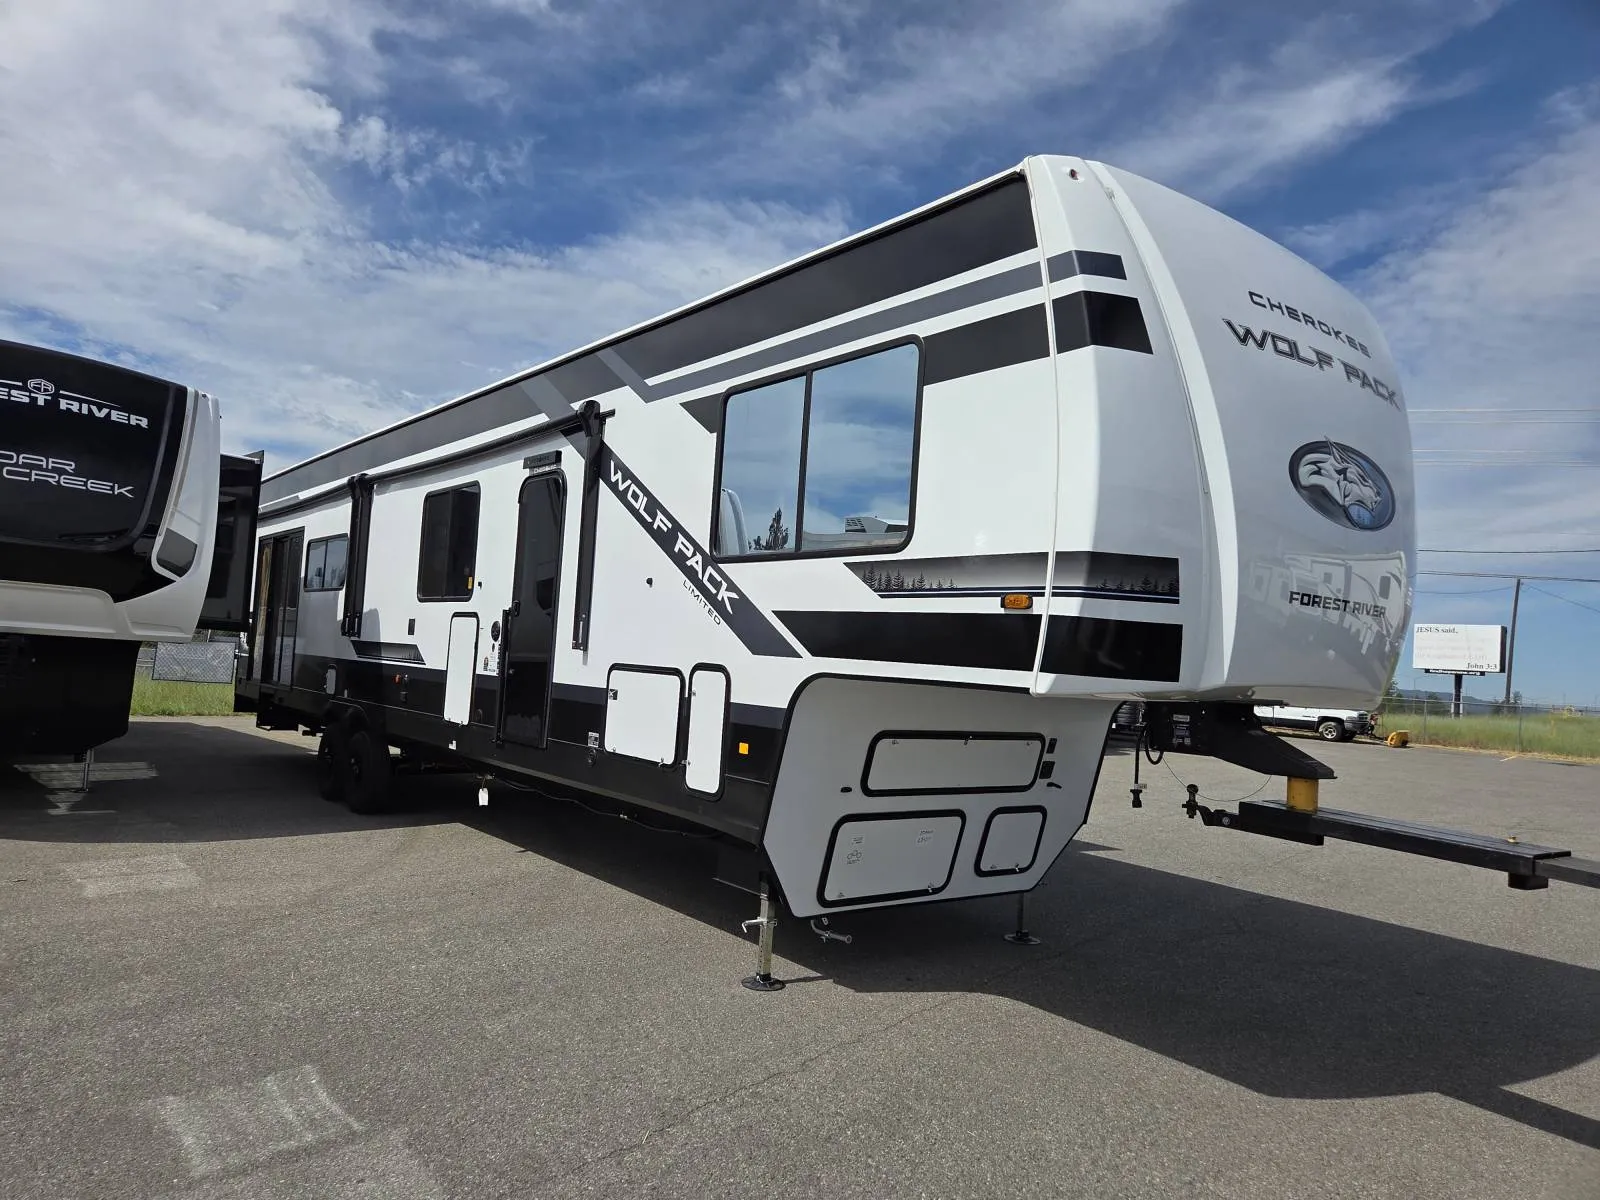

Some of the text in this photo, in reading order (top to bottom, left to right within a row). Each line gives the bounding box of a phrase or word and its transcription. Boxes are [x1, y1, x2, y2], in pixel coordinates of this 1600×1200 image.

[1248, 290, 1372, 359] CHEROKEE
[1222, 318, 1402, 412] WOLF PACK
[58, 397, 149, 429] RIVER
[2, 466, 135, 498] CREEK
[610, 459, 740, 615] WOLF PACK
[682, 579, 722, 626] LIMITED
[1288, 590, 1387, 618] FOREST RIVER
[1416, 626, 1440, 634] JESUS
[1466, 662, 1484, 670] John
